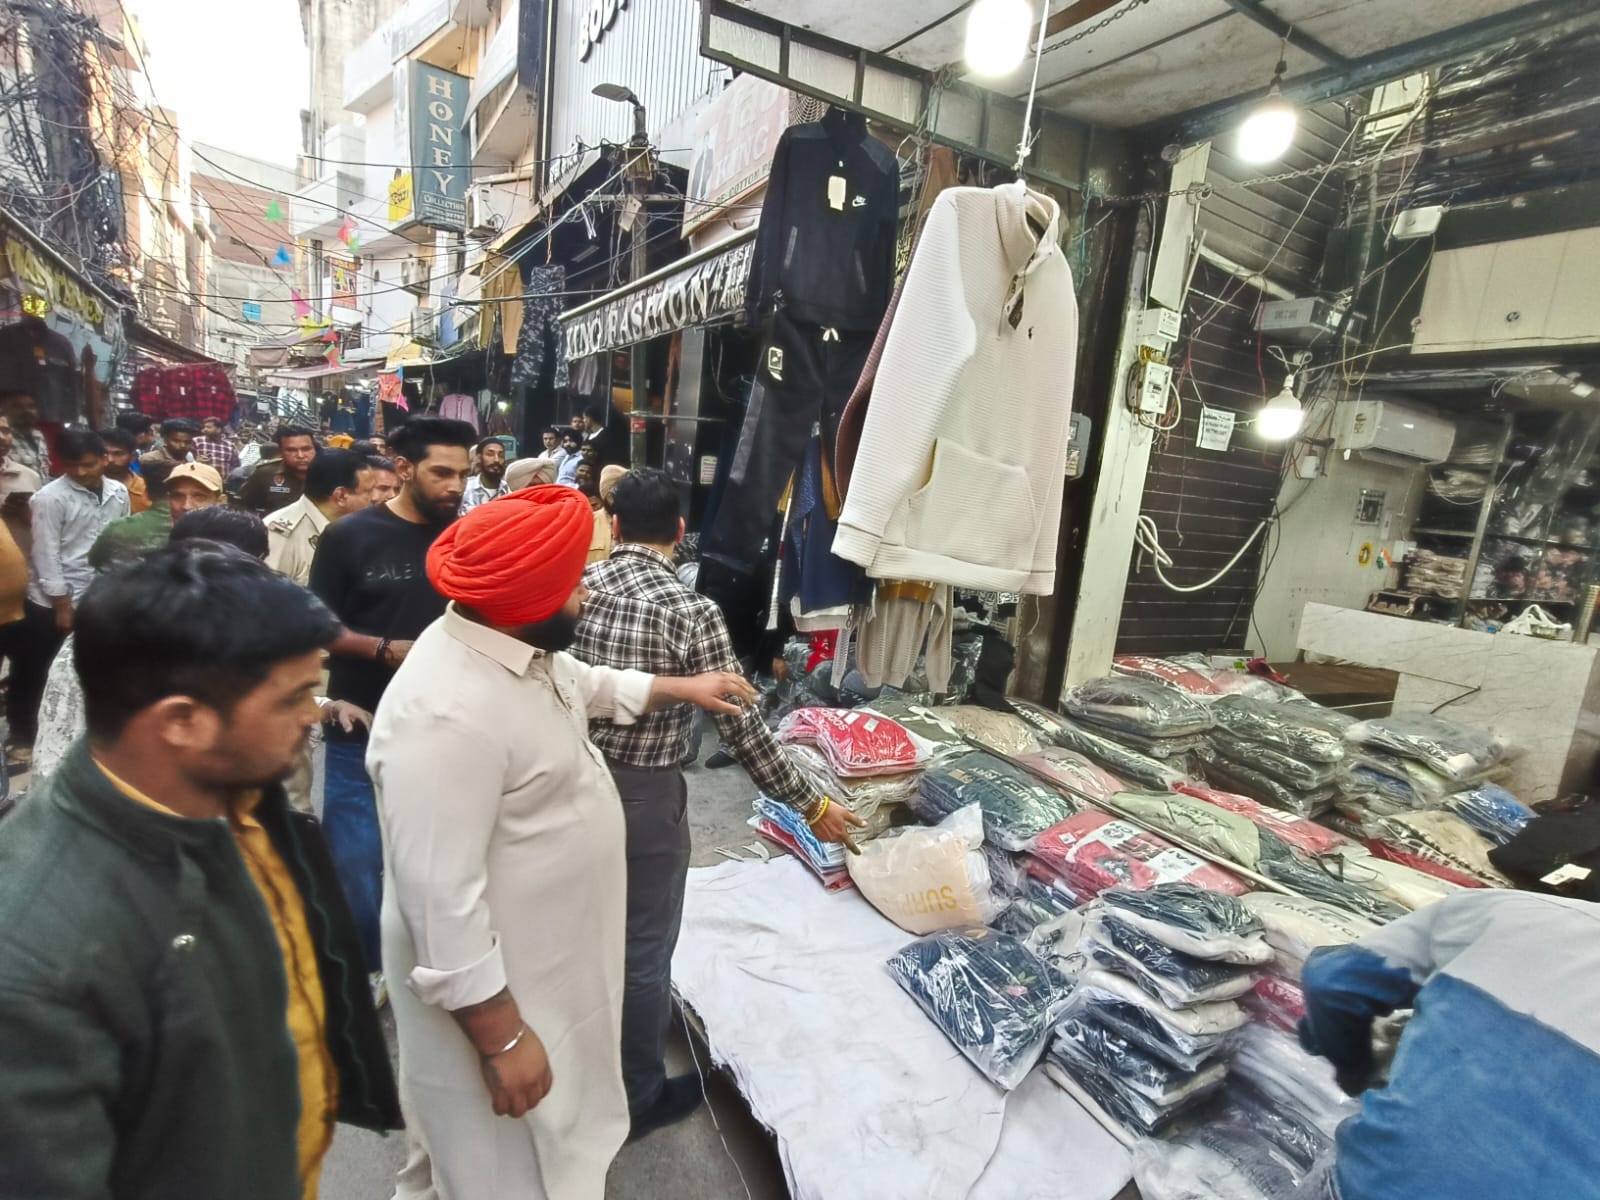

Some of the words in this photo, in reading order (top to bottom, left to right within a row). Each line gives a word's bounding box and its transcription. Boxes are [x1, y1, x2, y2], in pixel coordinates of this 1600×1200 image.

[427, 74, 455, 196] HONEY
[728, 167, 760, 198] COTTON
[564, 316, 602, 360] KING
[602, 277, 710, 347] FASHION
